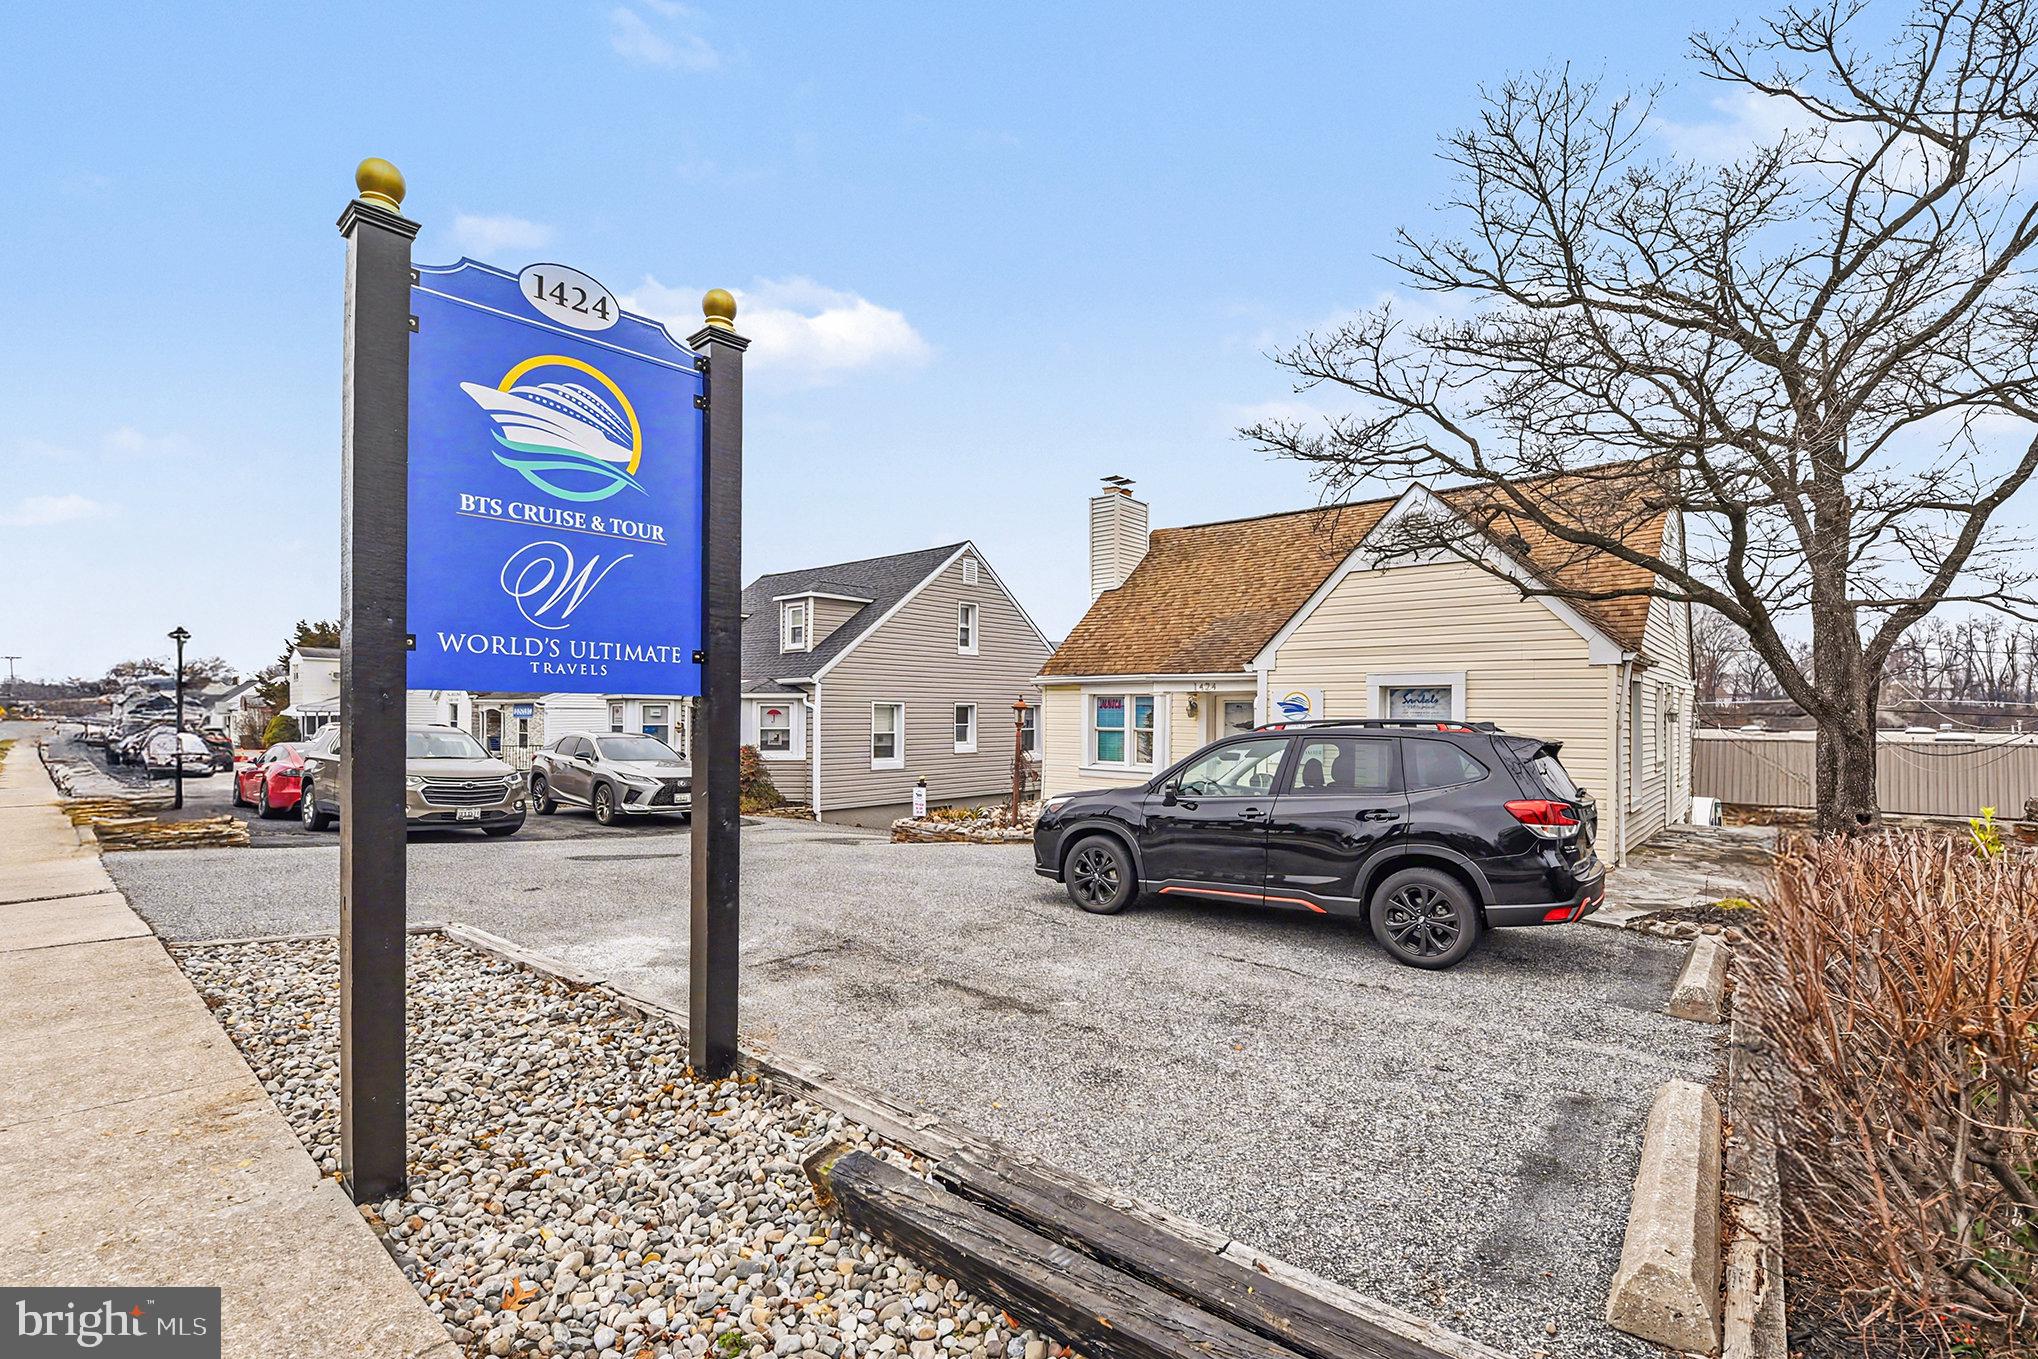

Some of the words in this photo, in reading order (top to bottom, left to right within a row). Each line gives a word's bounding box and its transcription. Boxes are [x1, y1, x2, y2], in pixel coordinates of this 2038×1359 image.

[532, 273, 610, 322] 1424
[459, 493, 503, 516] BTS
[508, 502, 587, 529] CRUISE
[591, 515, 606, 533] &
[609, 518, 667, 542] TOUR
[436, 632, 560, 659] WORLD'S
[569, 640, 682, 664] ULTIMATE
[529, 661, 608, 676] TRAVELS
[1193, 681, 1217, 691] 1424
